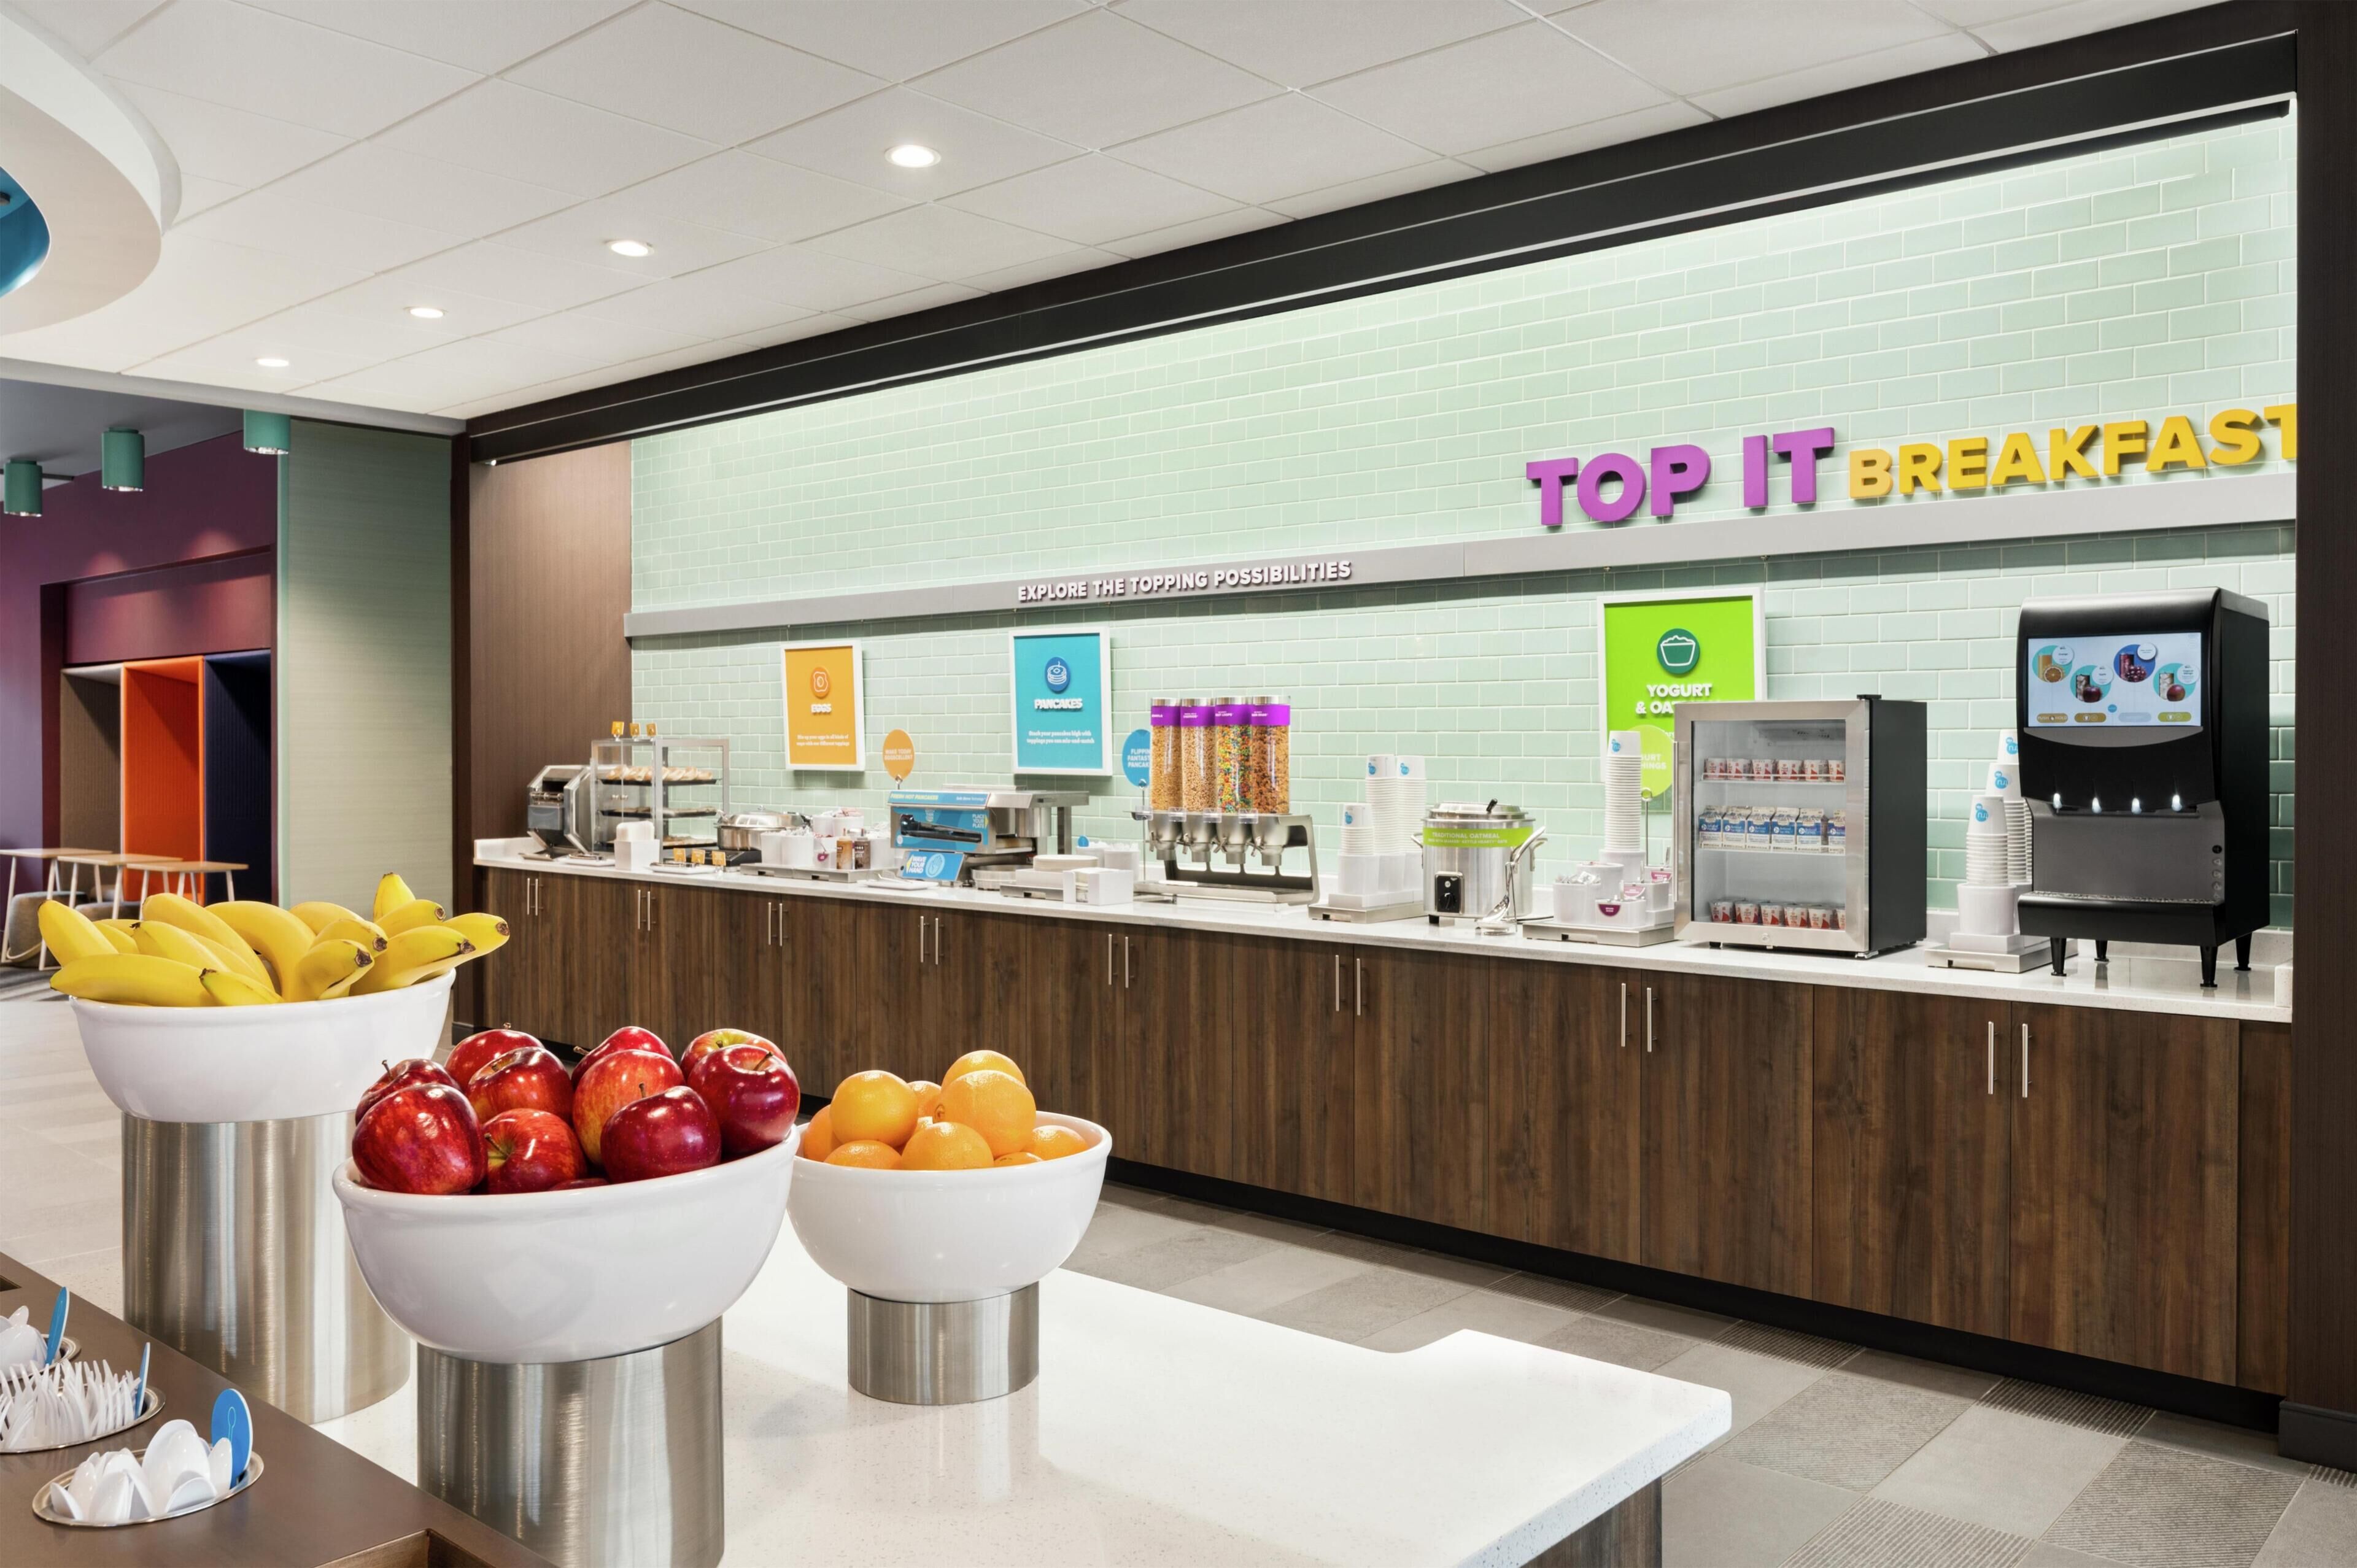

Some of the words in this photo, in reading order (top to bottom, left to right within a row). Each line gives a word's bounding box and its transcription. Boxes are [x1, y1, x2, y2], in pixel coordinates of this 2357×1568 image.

[1527, 444, 1711, 526] TOP
[1743, 427, 1835, 508] IT
[1849, 403, 2297, 498] BREAKFAST
[1018, 581, 1088, 601] EXPLORE
[1093, 577, 1124, 596] THE
[1130, 571, 1208, 592] TOPPING
[1213, 560, 1352, 586] POSSIBILITIES
[1646, 683, 1713, 697] YOGURT
[1034, 698, 1083, 710] PANCAKES
[1635, 701, 1647, 714] &
